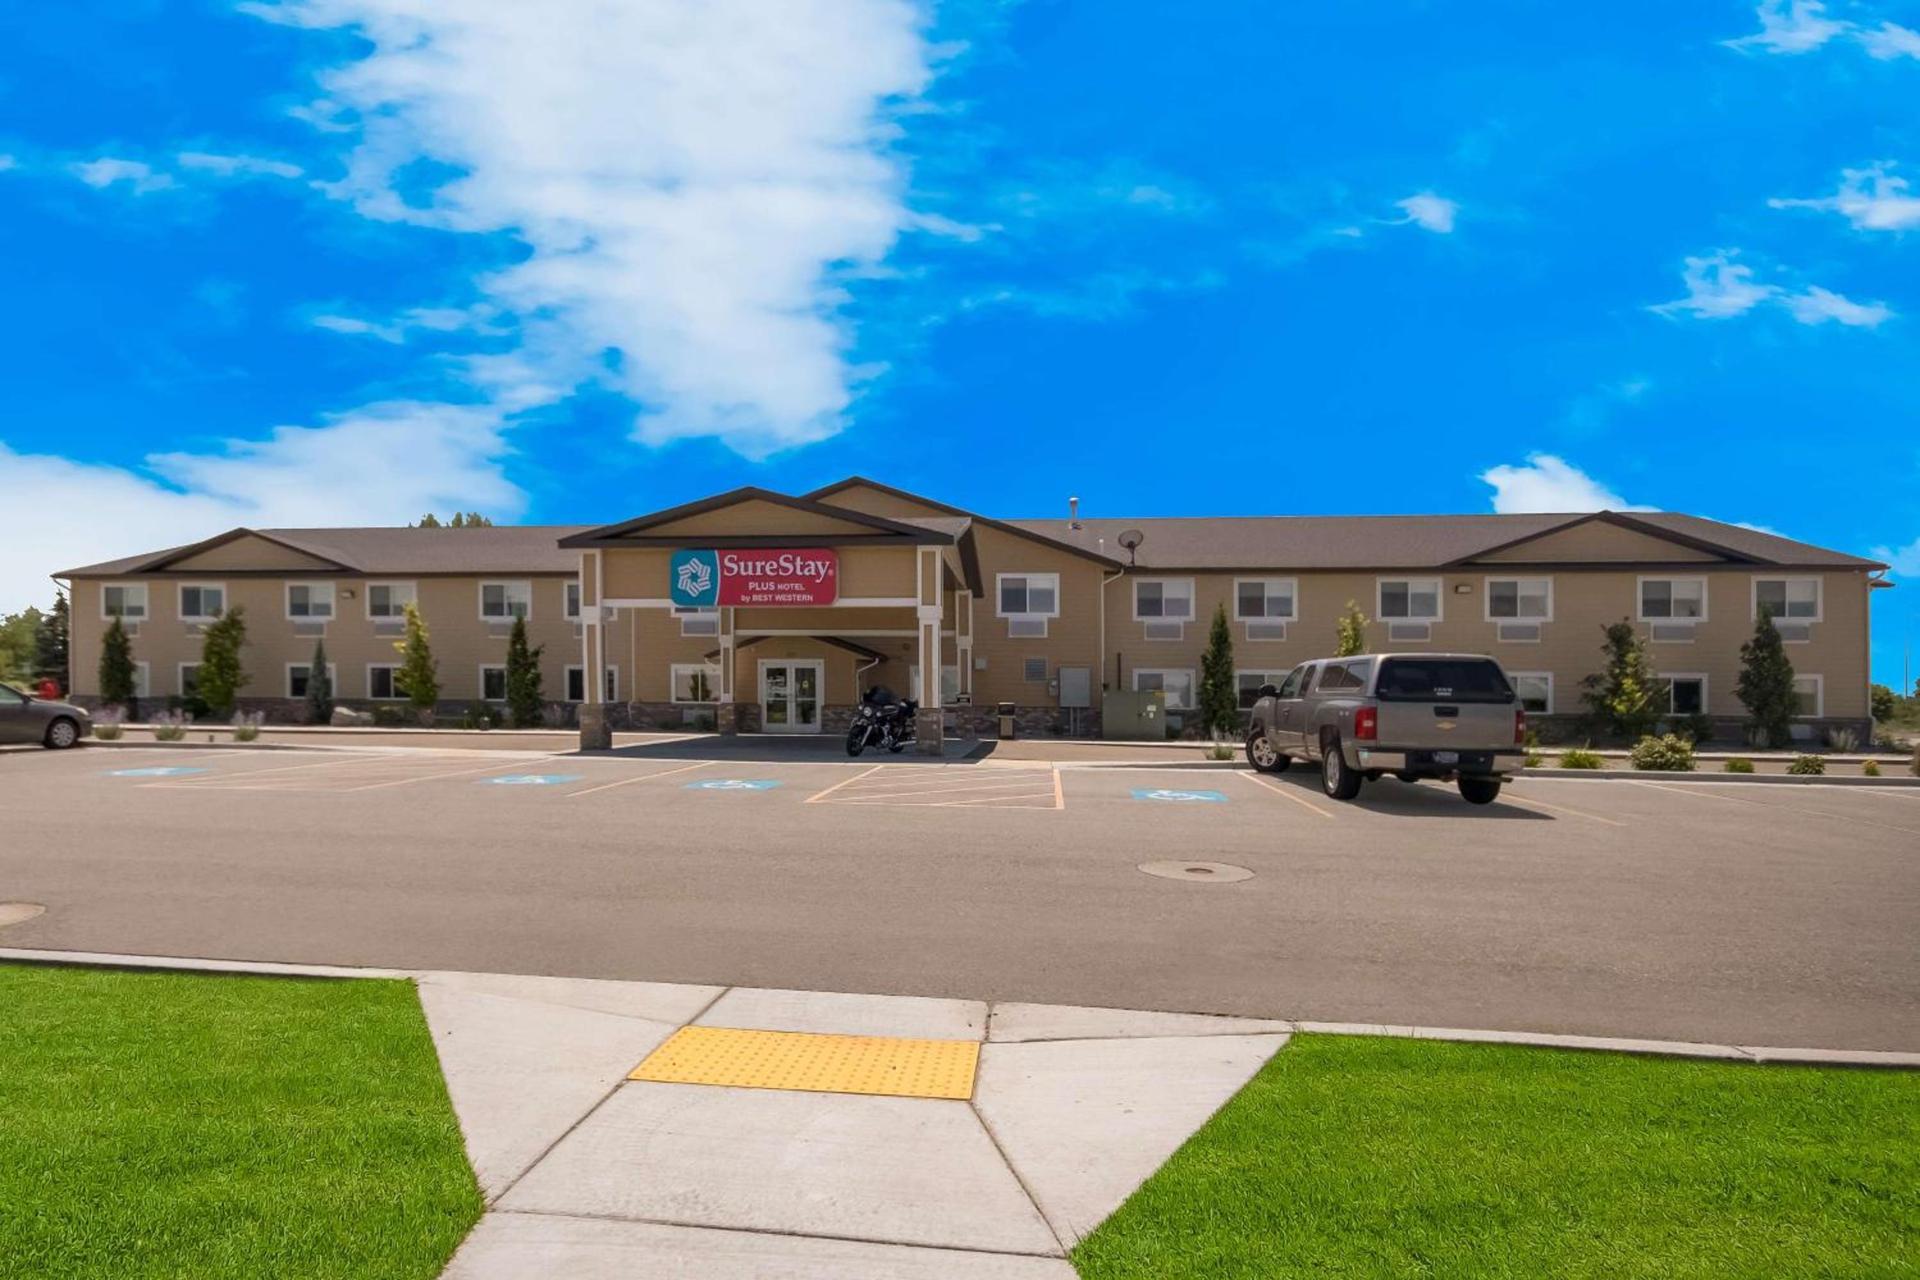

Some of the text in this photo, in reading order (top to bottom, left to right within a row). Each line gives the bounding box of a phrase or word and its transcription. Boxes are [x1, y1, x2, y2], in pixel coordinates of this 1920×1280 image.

[723, 554, 830, 583] SureStay
[749, 582, 805, 591] PLUS HOTEL
[741, 594, 813, 603] by BEST WESTERN
